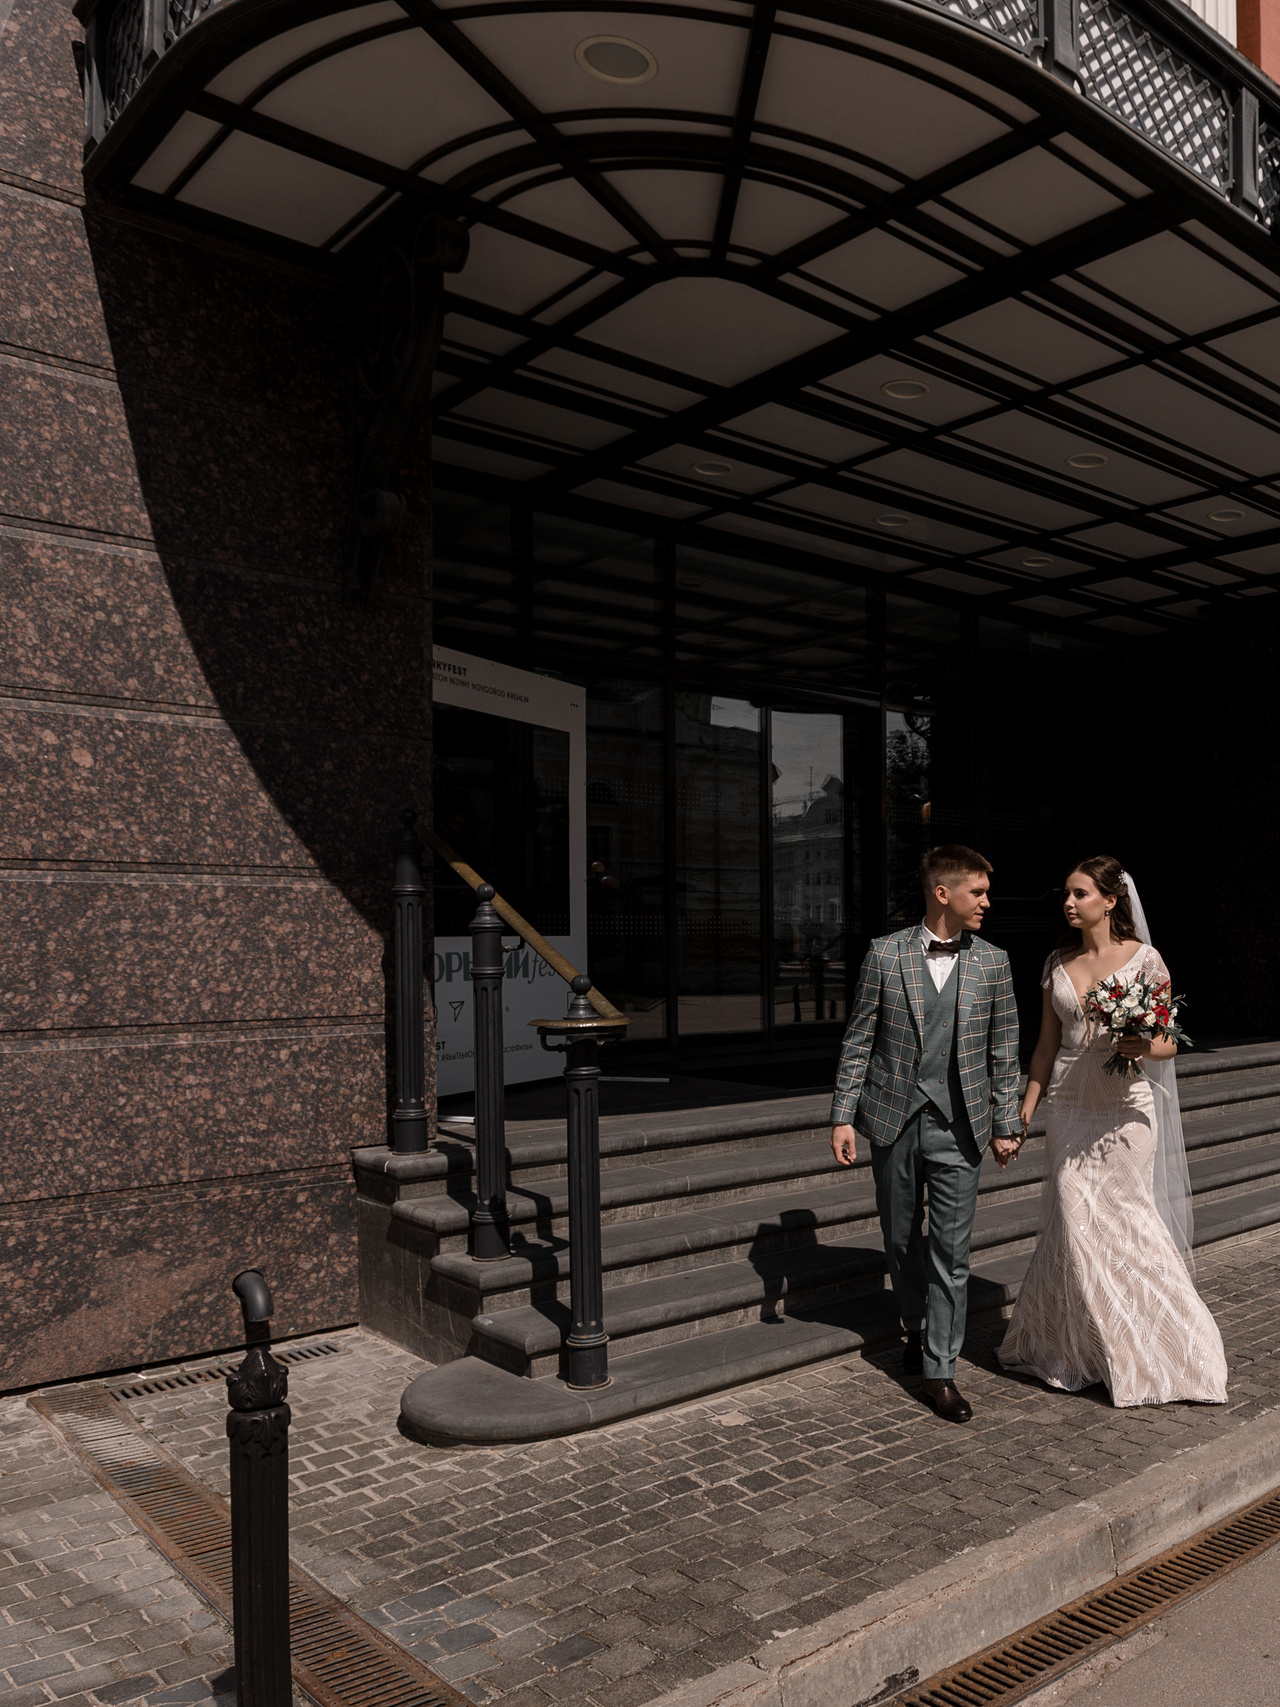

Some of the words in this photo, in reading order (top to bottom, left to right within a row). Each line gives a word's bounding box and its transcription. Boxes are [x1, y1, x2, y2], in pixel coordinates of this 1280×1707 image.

[449, 676, 470, 688] NIZHNY
[471, 683, 506, 698] NOVGOROD
[506, 691, 529, 703] KREMLIN
